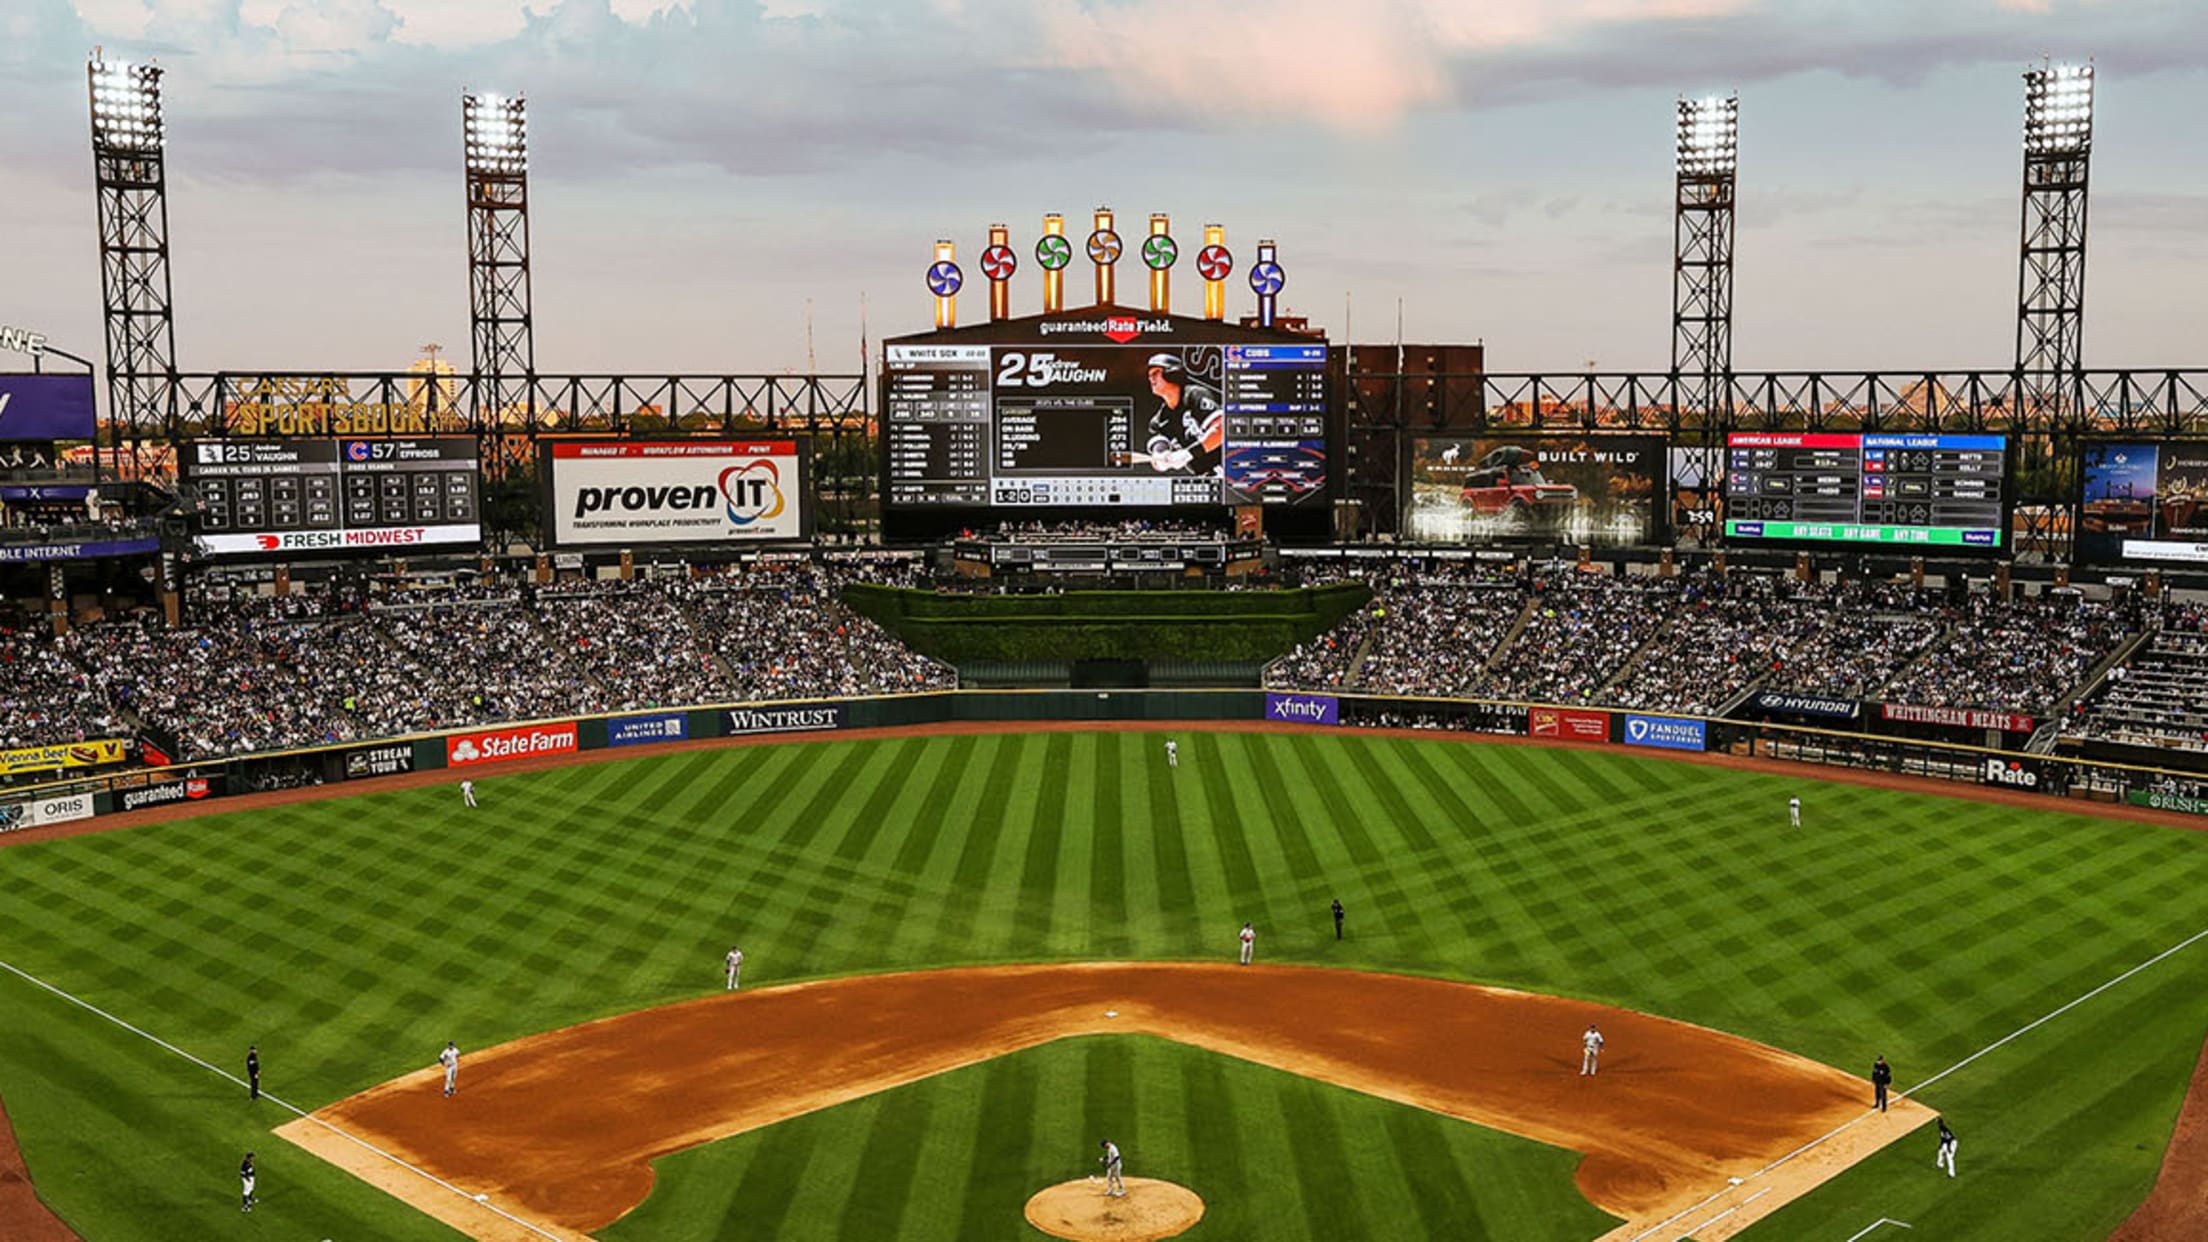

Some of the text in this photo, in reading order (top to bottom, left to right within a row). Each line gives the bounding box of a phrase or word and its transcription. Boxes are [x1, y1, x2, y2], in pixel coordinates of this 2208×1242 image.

[1040, 320, 1107, 335] guaranteed
[1108, 320, 1134, 332] Rate
[0, 326, 45, 357] NE
[909, 349, 937, 358] WHITE
[940, 349, 958, 358] SOX
[997, 353, 1055, 387] 25
[237, 377, 349, 397] CAESARS
[239, 402, 425, 434] SPORTSBOOK
[1732, 437, 1802, 445] AMERICAN LEAGUE
[1866, 438, 1938, 446] NATIONAL LEAGUE
[225, 445, 250, 462] 25
[255, 452, 298, 462] VAUGHN
[371, 443, 395, 459] 57
[1538, 451, 1587, 462] BUILT
[574, 479, 766, 518] proven IT
[997, 490, 1016, 501] 1-2
[1020, 490, 1029, 501] 0
[573, 519, 627, 529] TRANSFORMING
[672, 518, 722, 527] PRODUCTIVITY
[283, 529, 425, 547] FRESH MIDWEST
[25, 545, 82, 558] INTERNET
[1273, 698, 1327, 720] xfinity
[1785, 698, 1851, 713] HYUNDAI
[1886, 704, 1968, 727] WHITTINGHAM
[1970, 712, 2011, 730] MEATS
[615, 728, 664, 740] AIRLINES
[624, 721, 664, 731] UNITED
[1650, 723, 1702, 737] FANDUEL
[370, 746, 412, 763] STREAM
[1986, 760, 2038, 787] Rate
[123, 783, 184, 810] guaranteed
[2161, 795, 2200, 813] RUSH
[44, 799, 83, 816] ORIS
